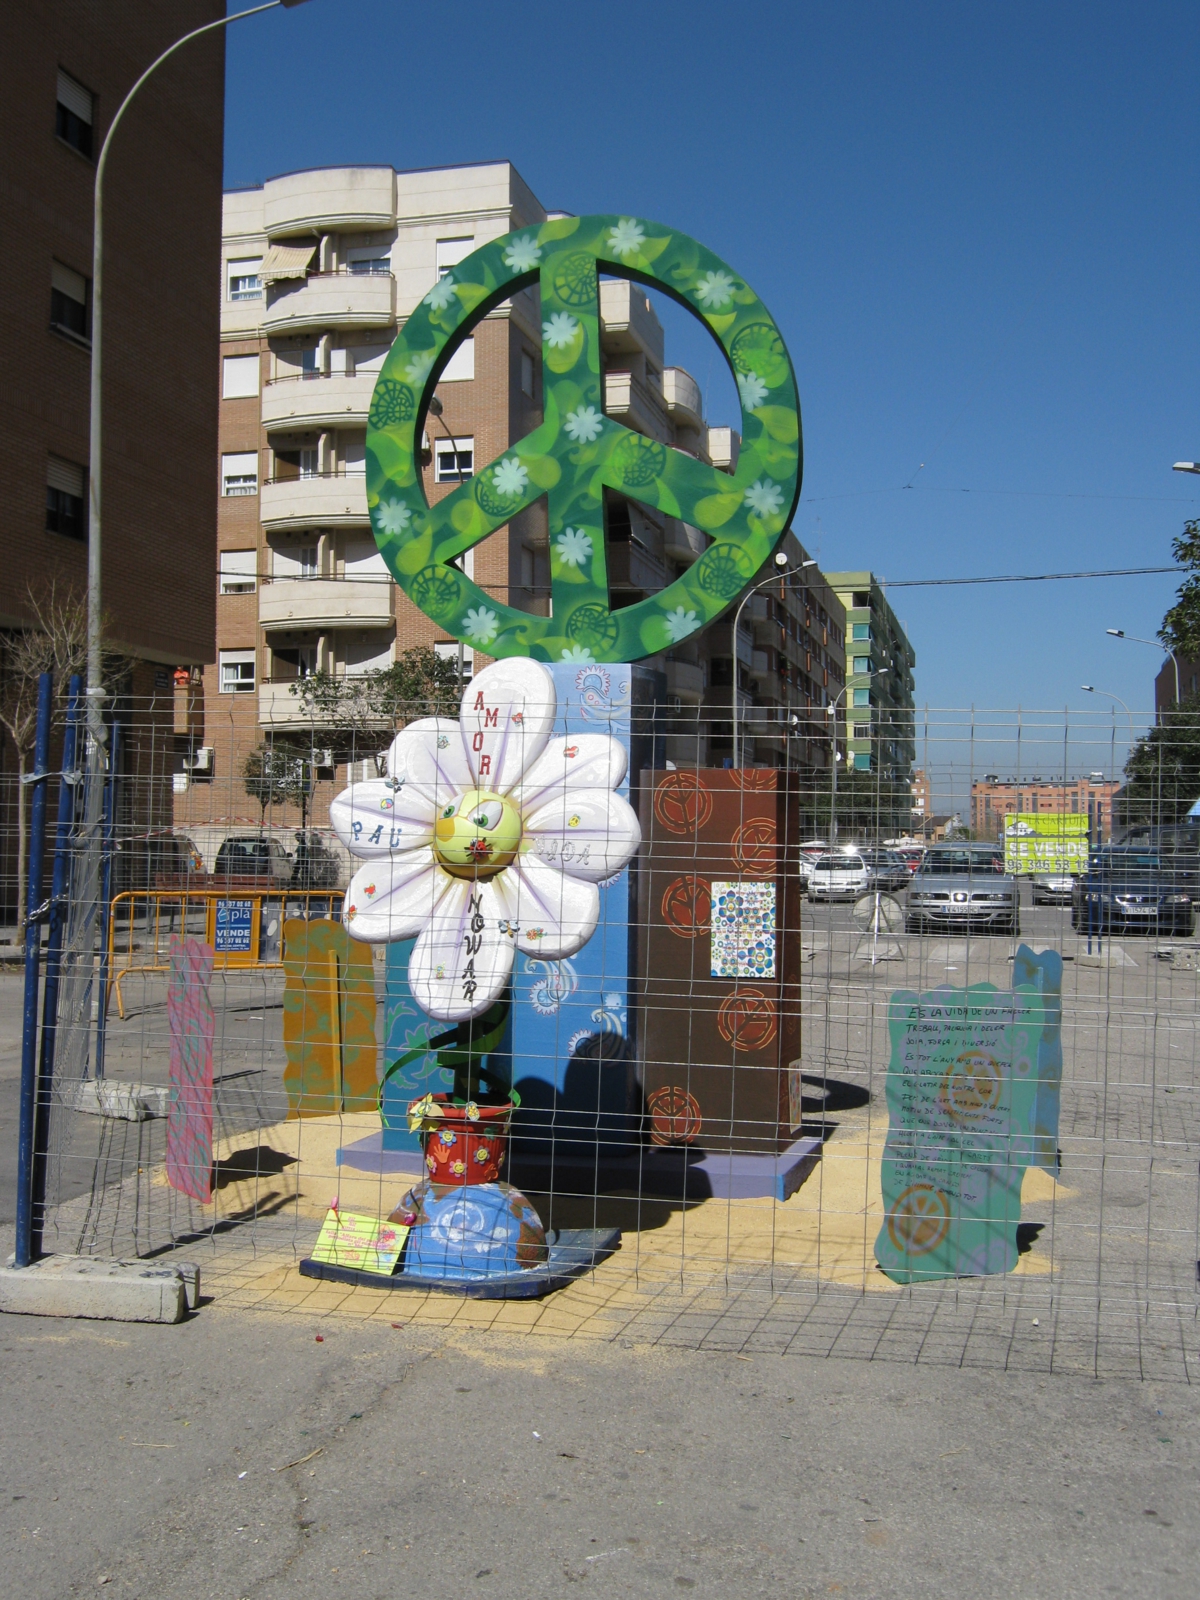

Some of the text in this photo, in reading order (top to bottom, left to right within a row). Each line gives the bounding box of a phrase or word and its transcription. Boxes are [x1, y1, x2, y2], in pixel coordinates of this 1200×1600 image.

[473, 691, 499, 775] AMOR
[351, 821, 402, 848] PAU
[1009, 842, 1089, 857] SE VENDE
[1007, 859, 1022, 870] 96
[216, 929, 251, 937] VENDE
[931, 1008, 942, 1017] LA
[945, 1007, 967, 1017] VIDA
